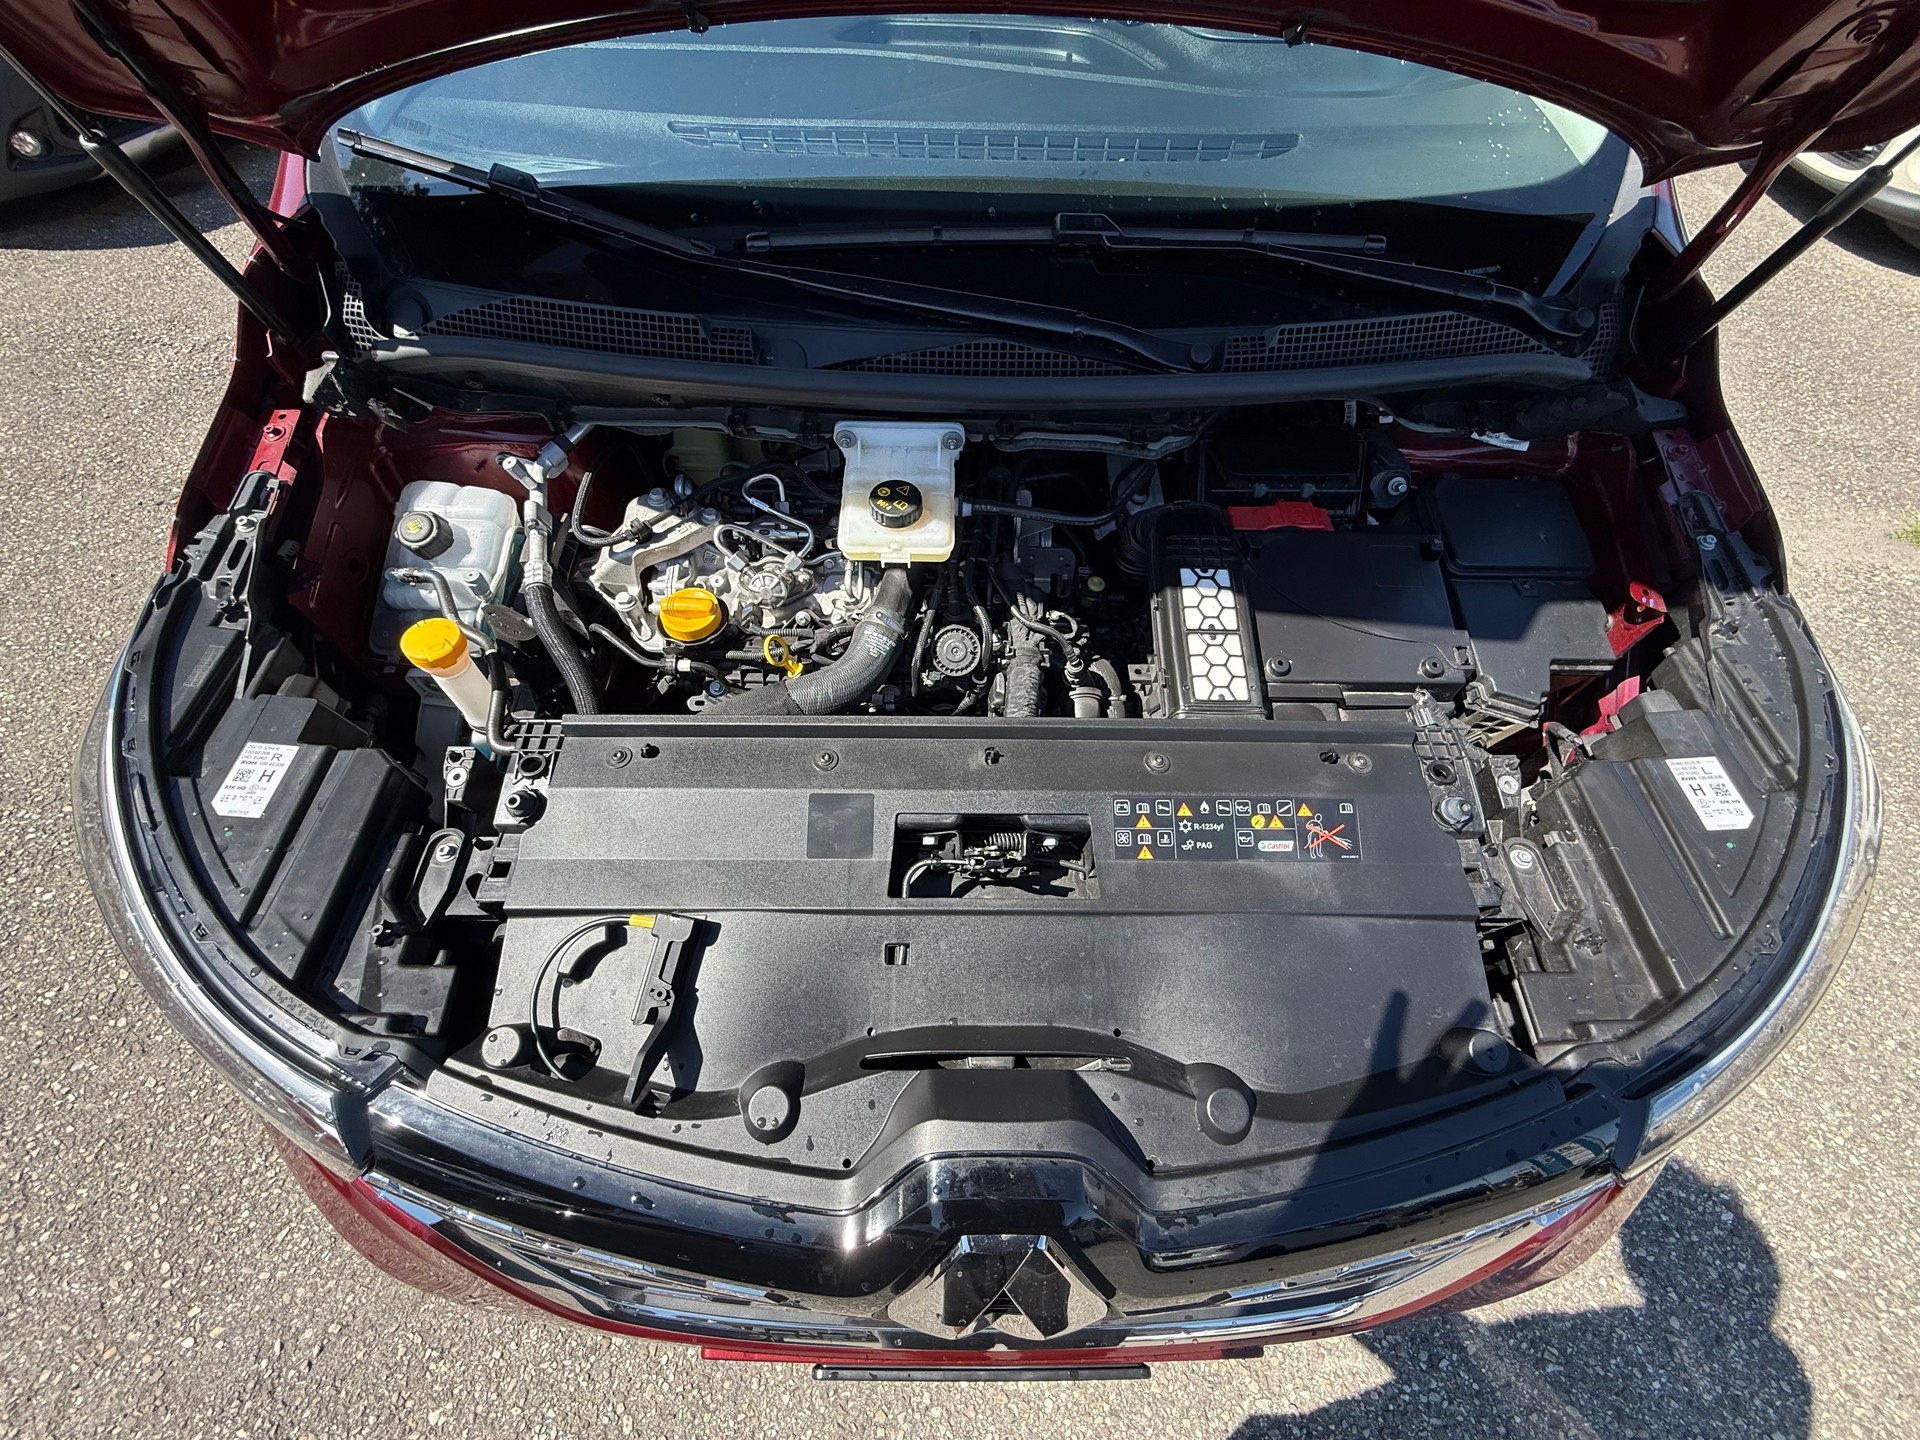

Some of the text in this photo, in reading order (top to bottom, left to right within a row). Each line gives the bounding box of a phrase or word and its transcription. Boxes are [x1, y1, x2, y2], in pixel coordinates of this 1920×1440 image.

[270, 753, 283, 762] R
[1700, 766, 1713, 775] L
[258, 769, 276, 783] H
[1688, 783, 1707, 797] H
[1193, 823, 1224, 832] R-1234yf
[1196, 841, 1213, 849] PAG
[1267, 842, 1291, 850] Castrol
